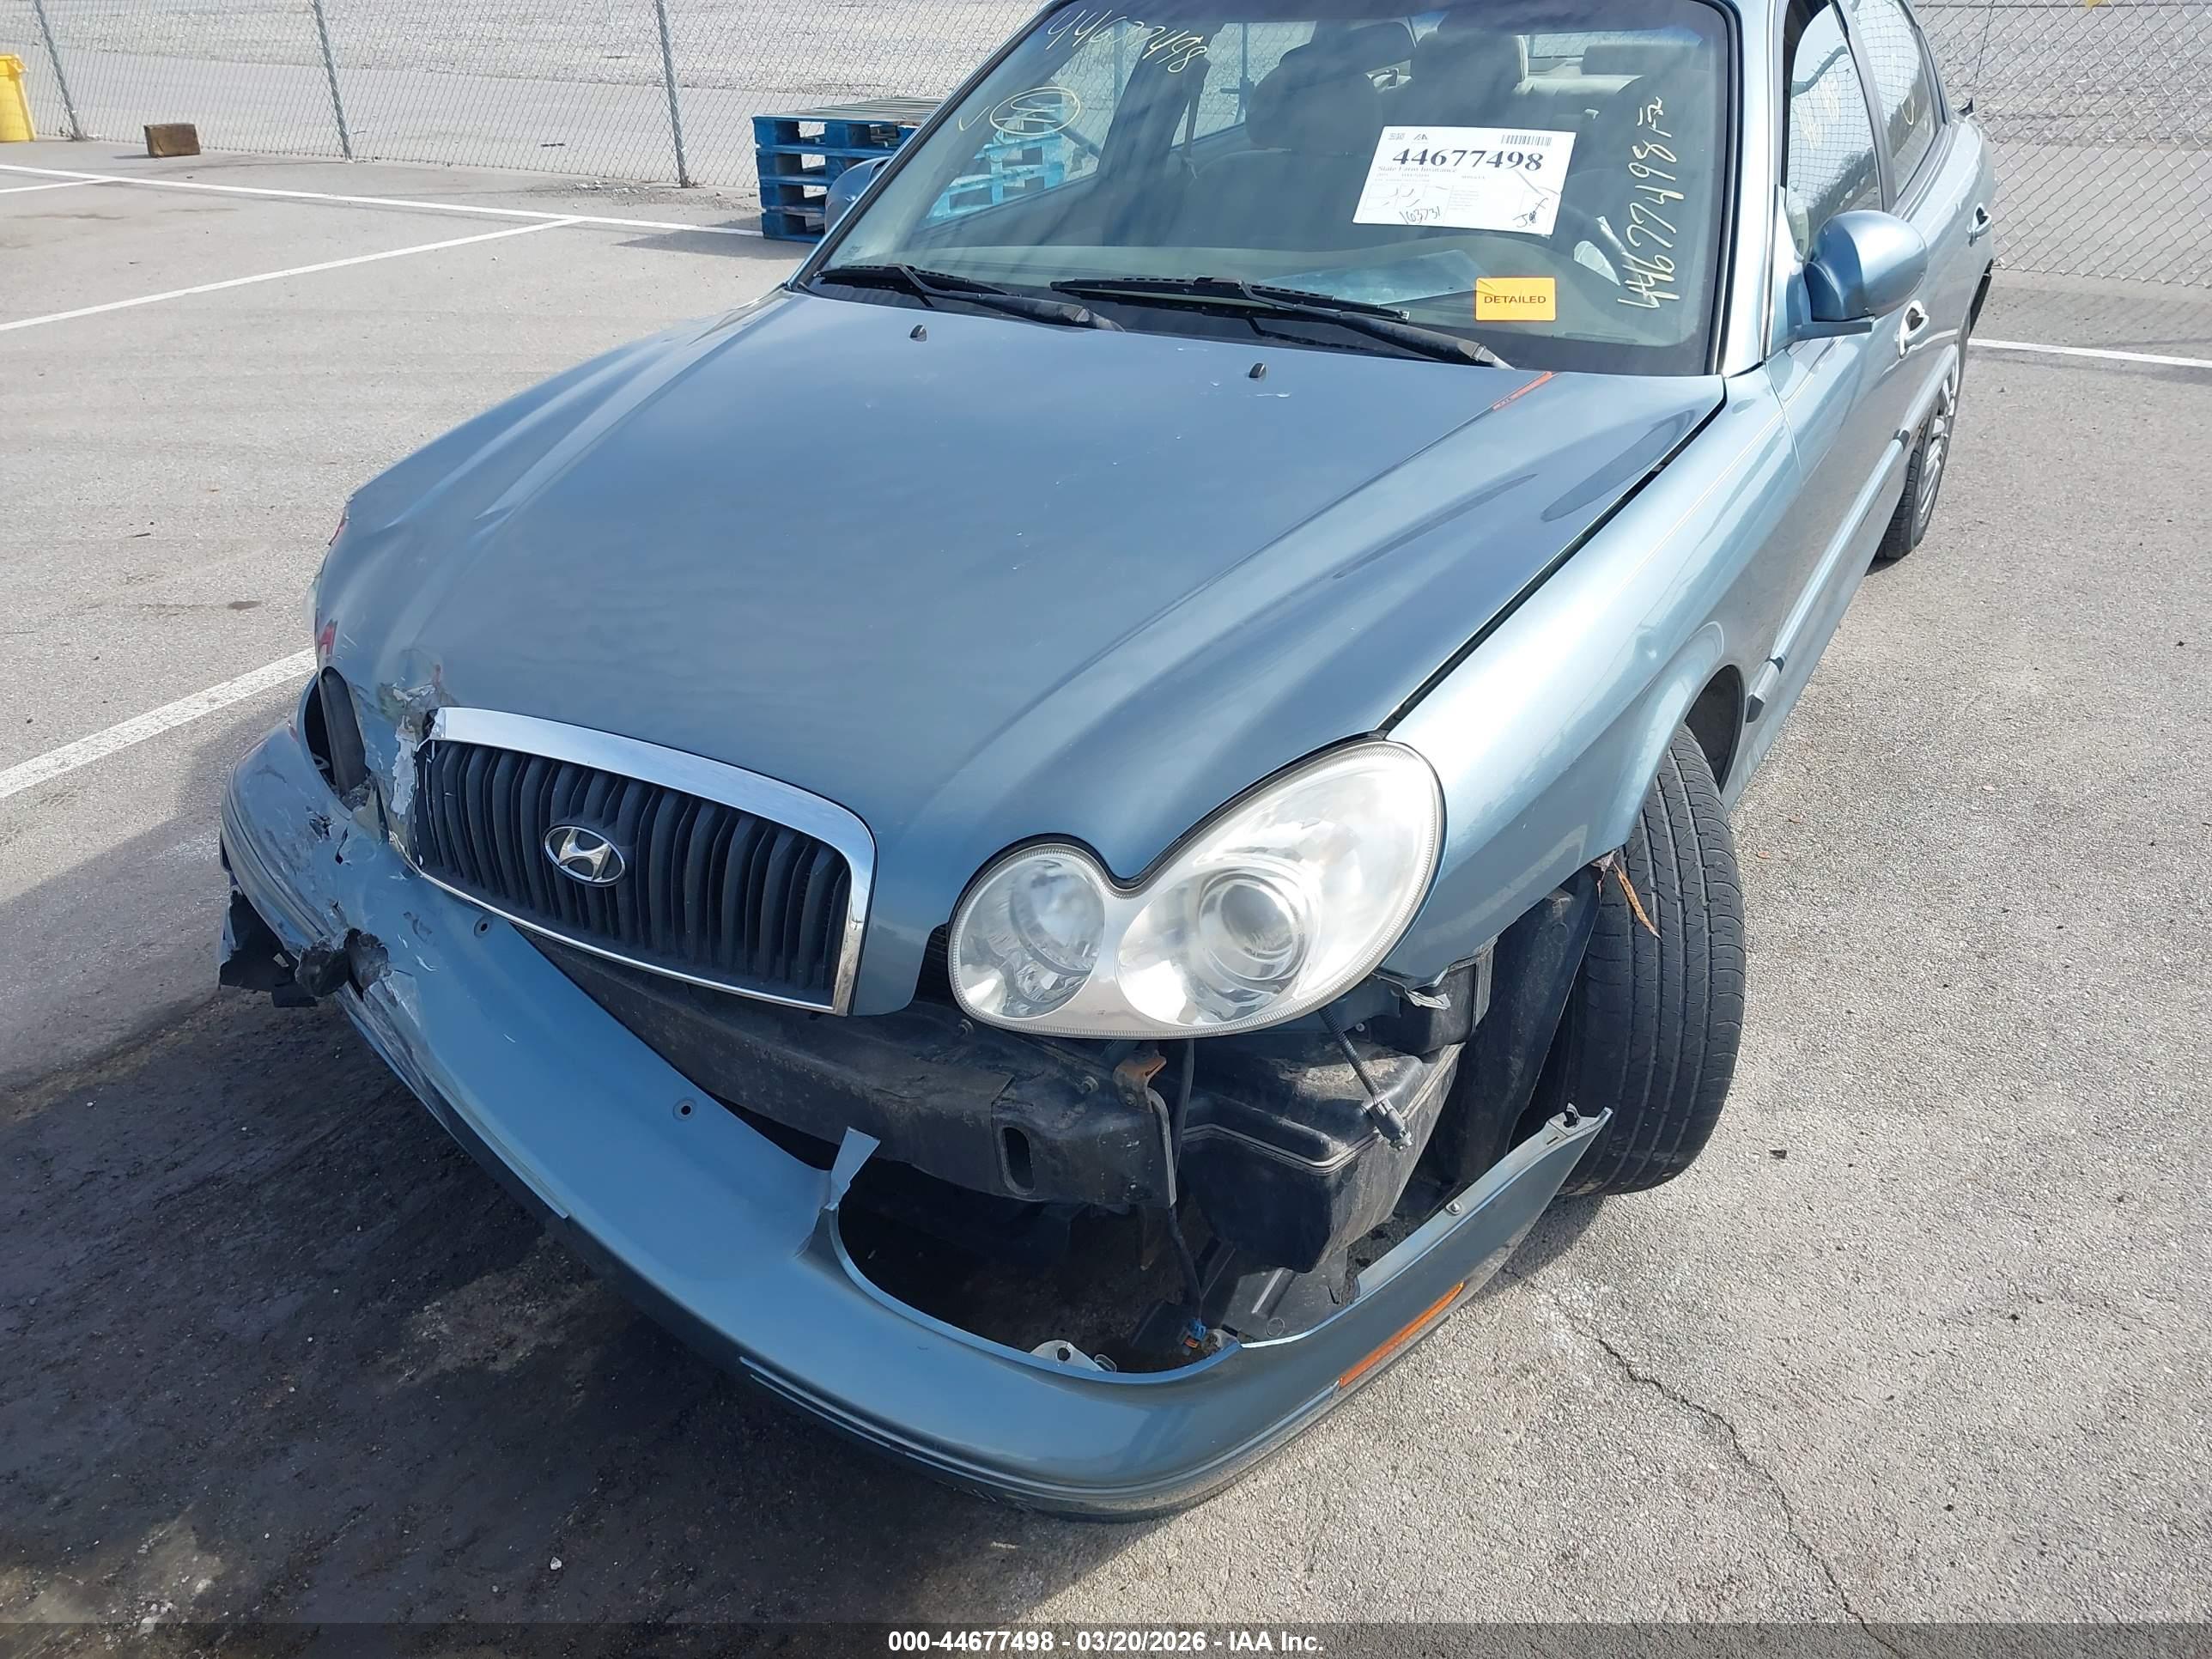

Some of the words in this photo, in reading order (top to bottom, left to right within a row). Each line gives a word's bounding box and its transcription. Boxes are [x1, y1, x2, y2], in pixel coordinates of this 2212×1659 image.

[1045, 9, 1208, 73] 44677498
[1392, 148, 1544, 171] 44677498
[1617, 139, 1685, 308] 44677498
[1484, 295, 1547, 304] DETAILED
